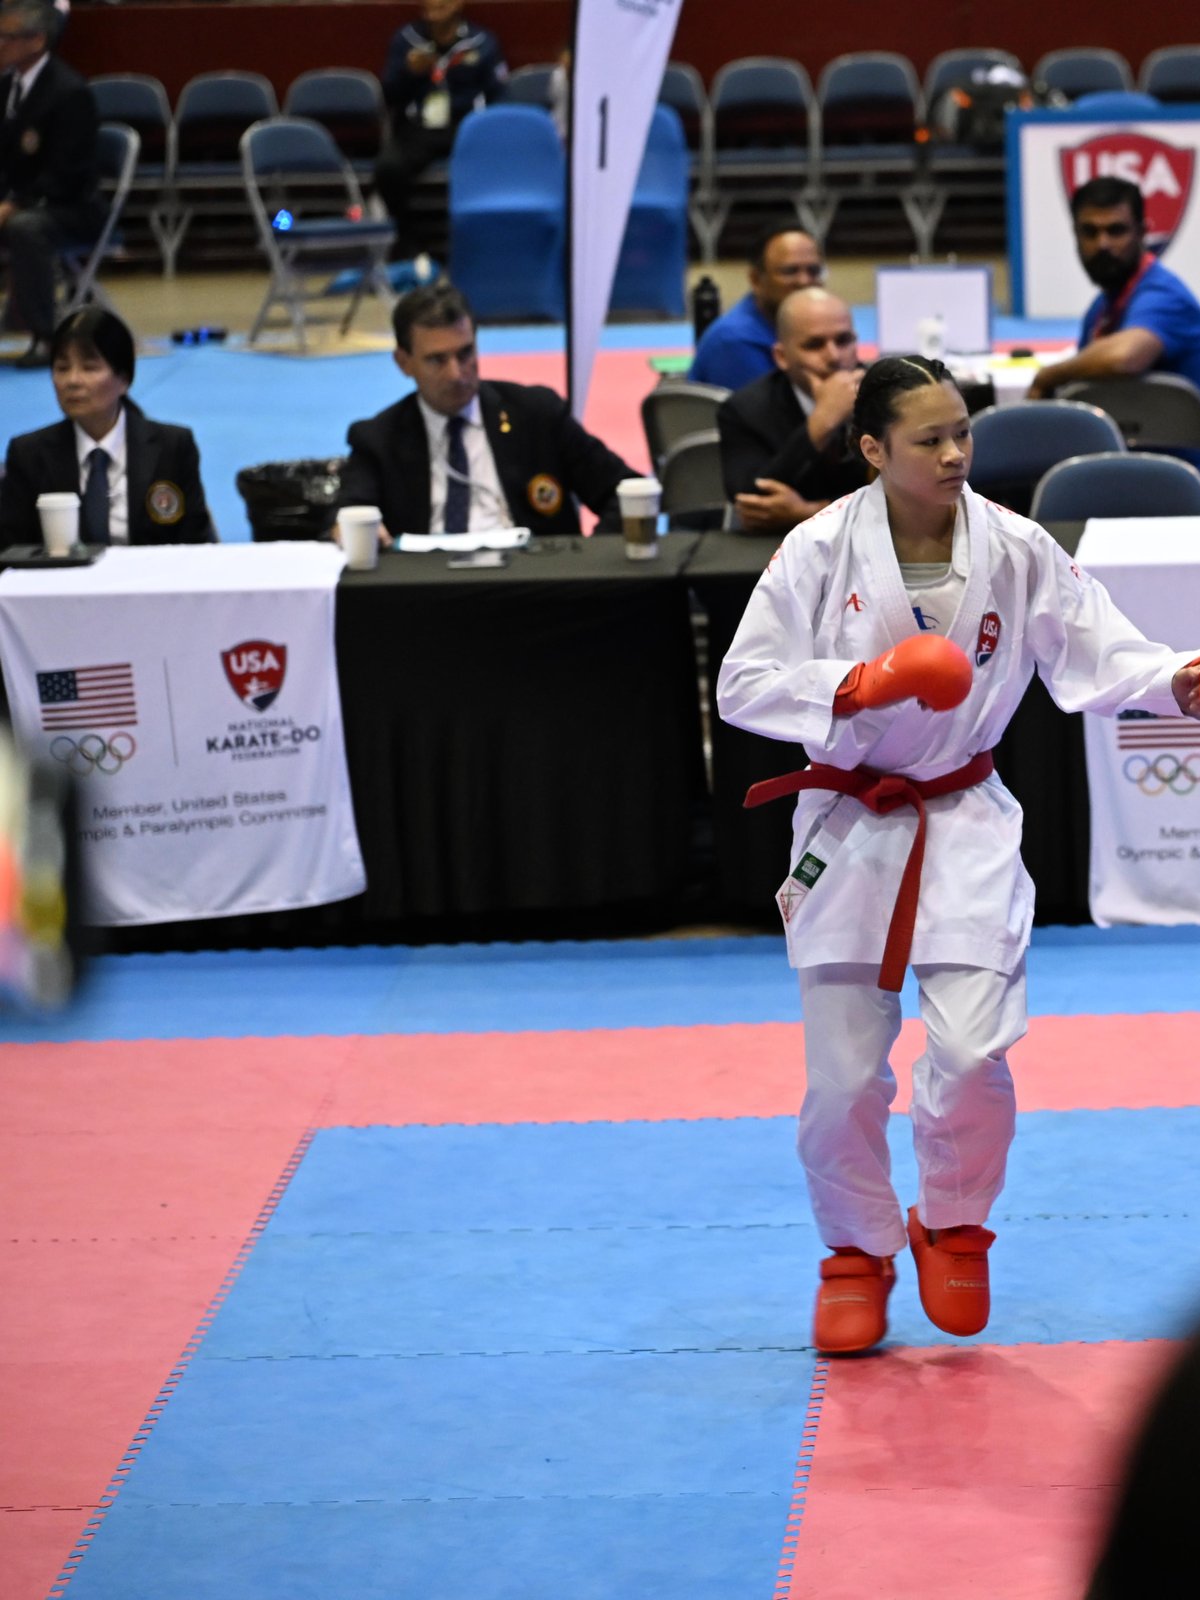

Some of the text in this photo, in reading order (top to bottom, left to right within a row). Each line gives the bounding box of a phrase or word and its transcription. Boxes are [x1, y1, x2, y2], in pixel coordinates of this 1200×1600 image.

[982, 618, 998, 639] USA
[229, 649, 281, 675] USA
[206, 725, 322, 754] KARATE-DO
[172, 794, 228, 813] United
[233, 788, 287, 807] States
[123, 822, 135, 837] &
[140, 812, 235, 835] Paralympic
